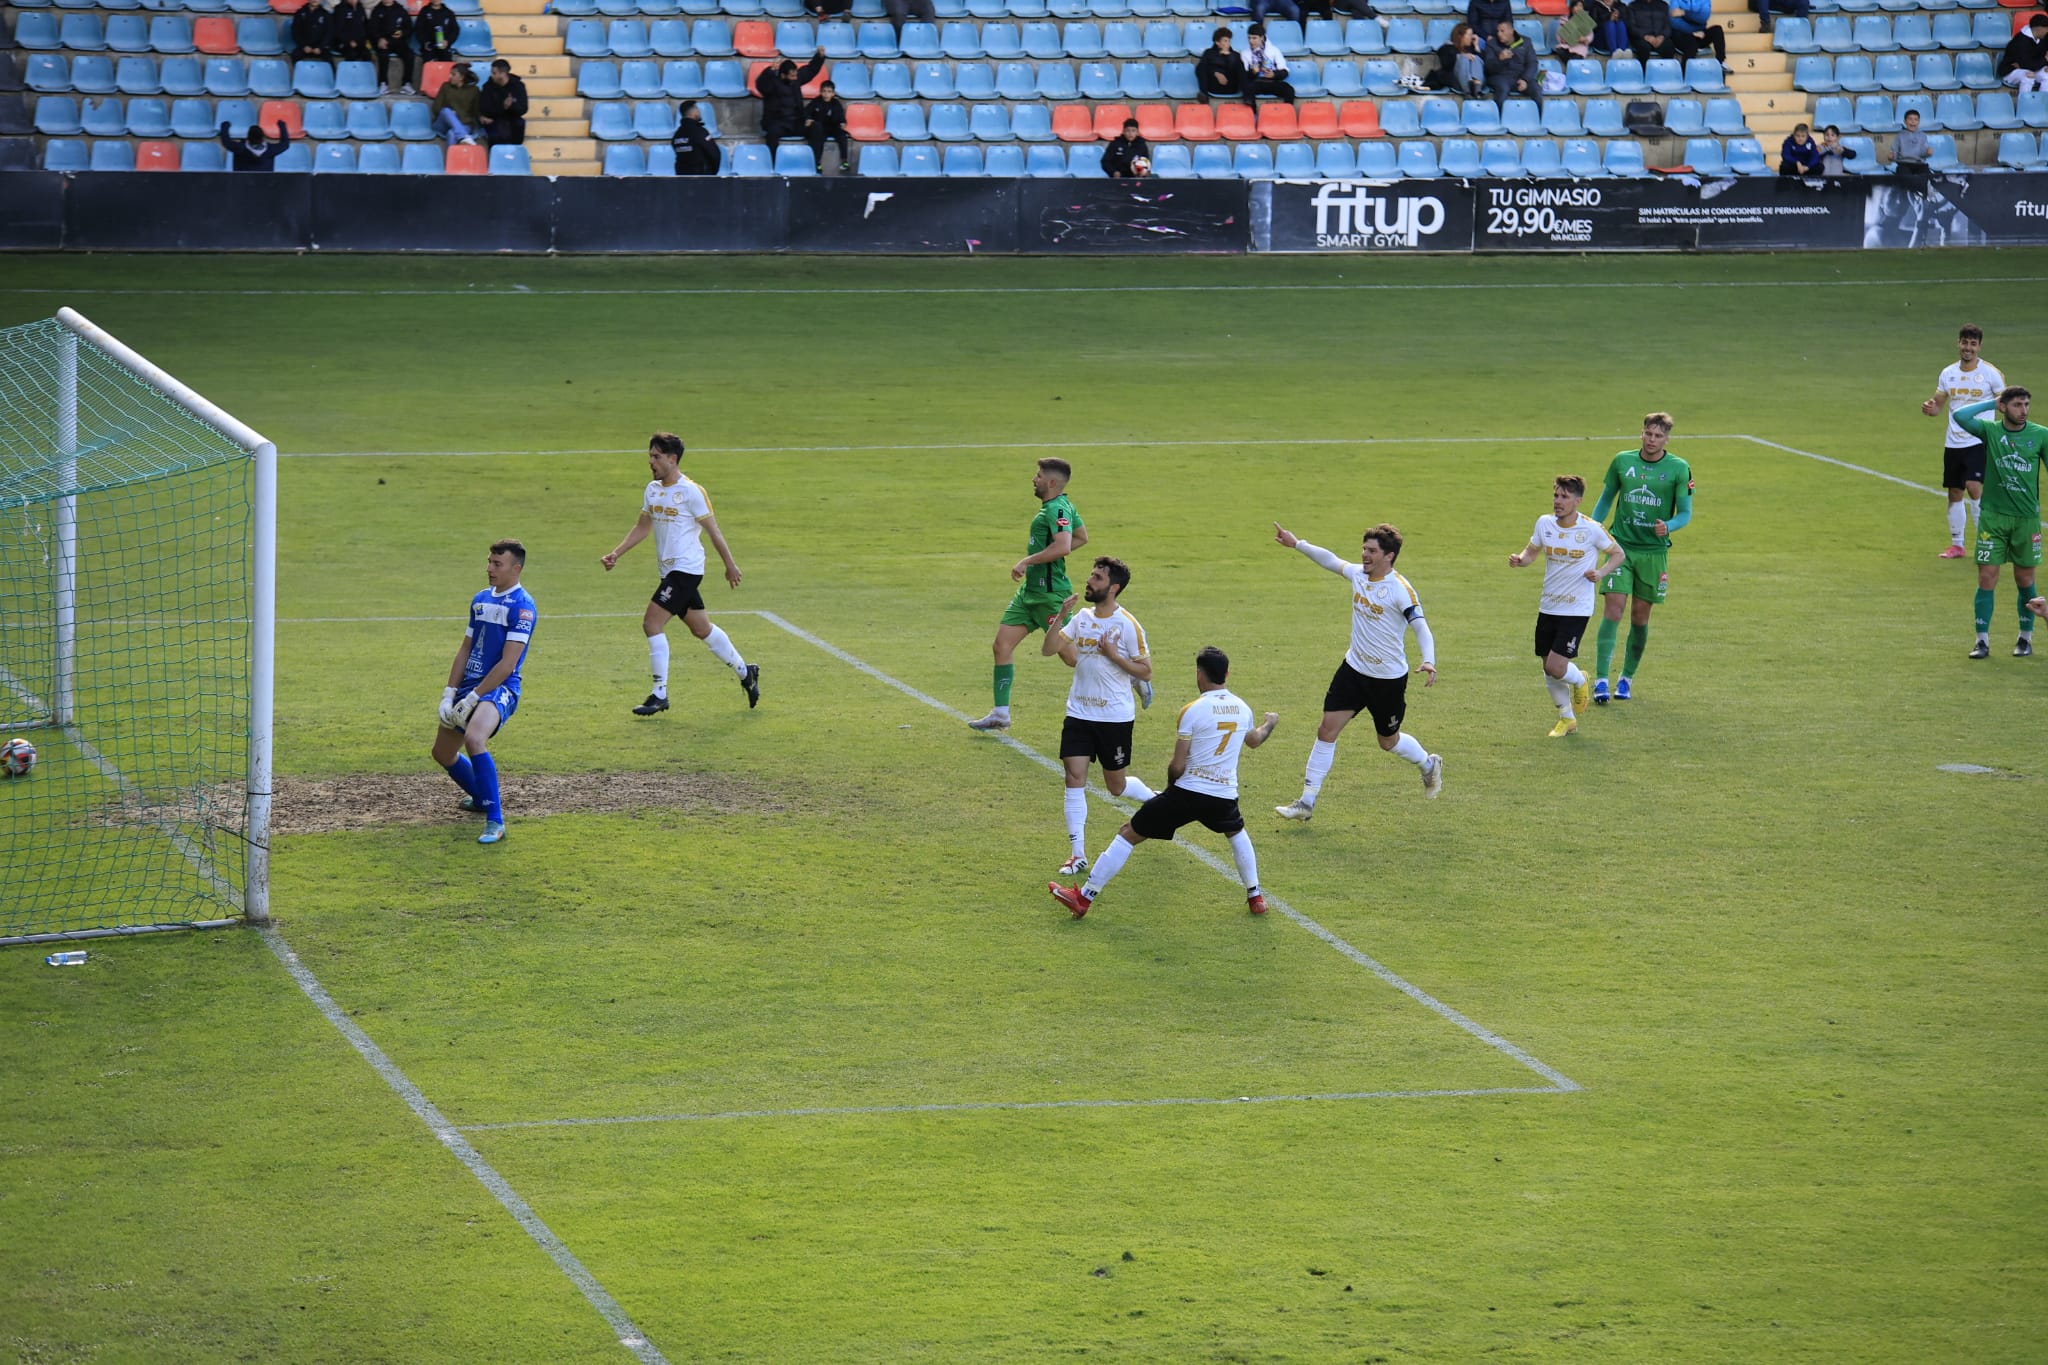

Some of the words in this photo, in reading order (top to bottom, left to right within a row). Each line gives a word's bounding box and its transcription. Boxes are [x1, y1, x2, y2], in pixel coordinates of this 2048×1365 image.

[519, 24, 528, 34] 6
[1488, 188, 1513, 206] TU
[1515, 187, 1602, 207] GIMNASIO
[1311, 183, 1445, 247] fitup
[1638, 207, 1652, 215] SIN
[1701, 207, 1710, 215] NI
[1710, 206, 1762, 216] CONDICIONES
[1762, 206, 1774, 215] DE
[2014, 199, 2048, 220] fitu
[1316, 234, 1371, 247] SMART
[1374, 234, 1408, 247] GYM
[1977, 550, 1990, 562] 22
[1607, 577, 1614, 590] 4
[1212, 704, 1240, 716] ALVARO
[1213, 721, 1238, 756] 7
